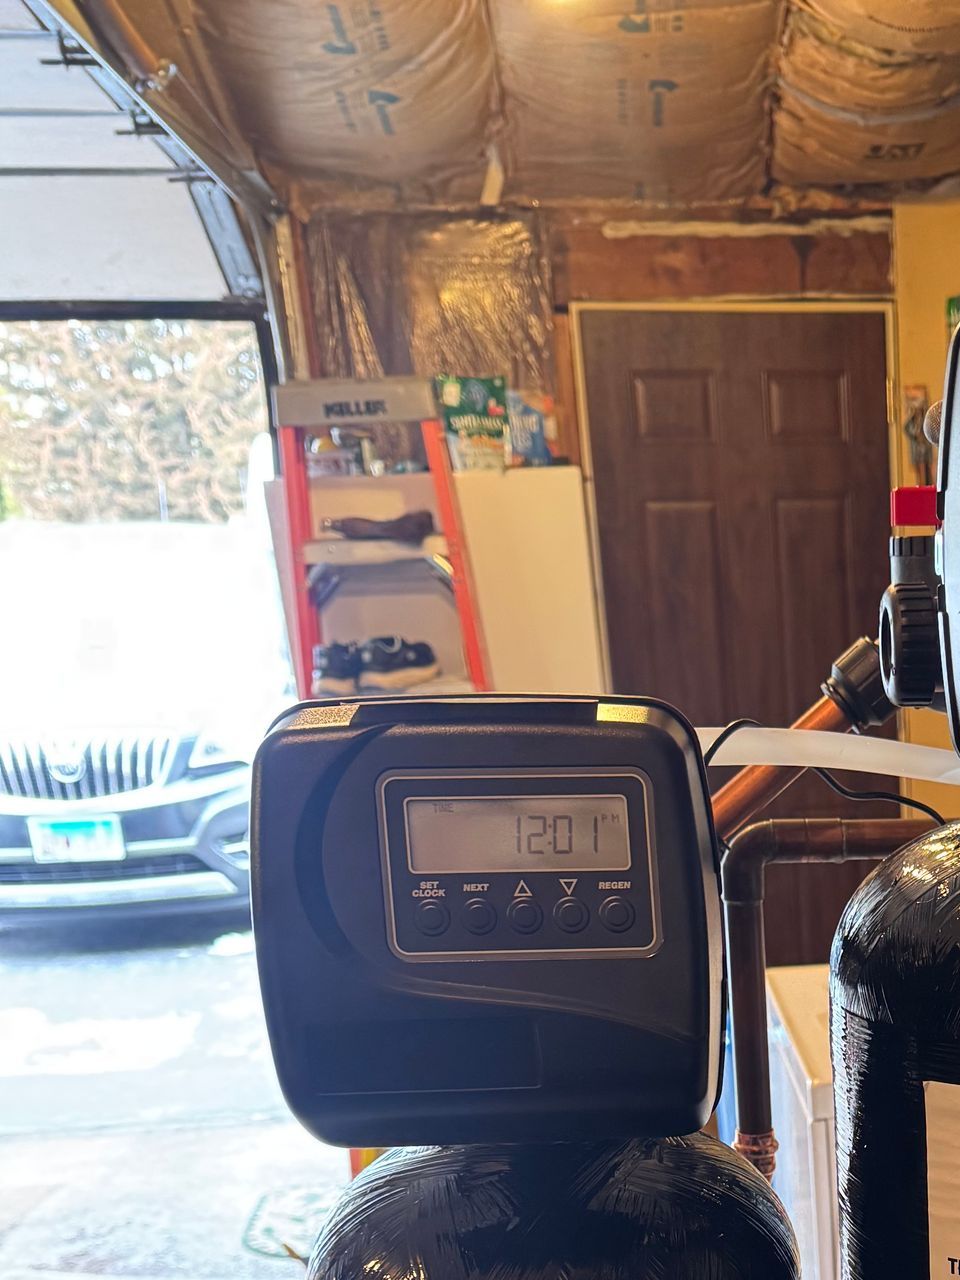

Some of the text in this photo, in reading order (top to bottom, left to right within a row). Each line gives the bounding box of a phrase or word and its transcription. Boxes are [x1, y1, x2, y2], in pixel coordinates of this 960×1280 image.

[433, 803, 454, 814] TIME
[516, 815, 599, 855] 12:01
[420, 881, 439, 890] SET
[463, 883, 489, 892] NEXT
[598, 881, 631, 890] REGEN
[412, 888, 445, 897] CLOCK
